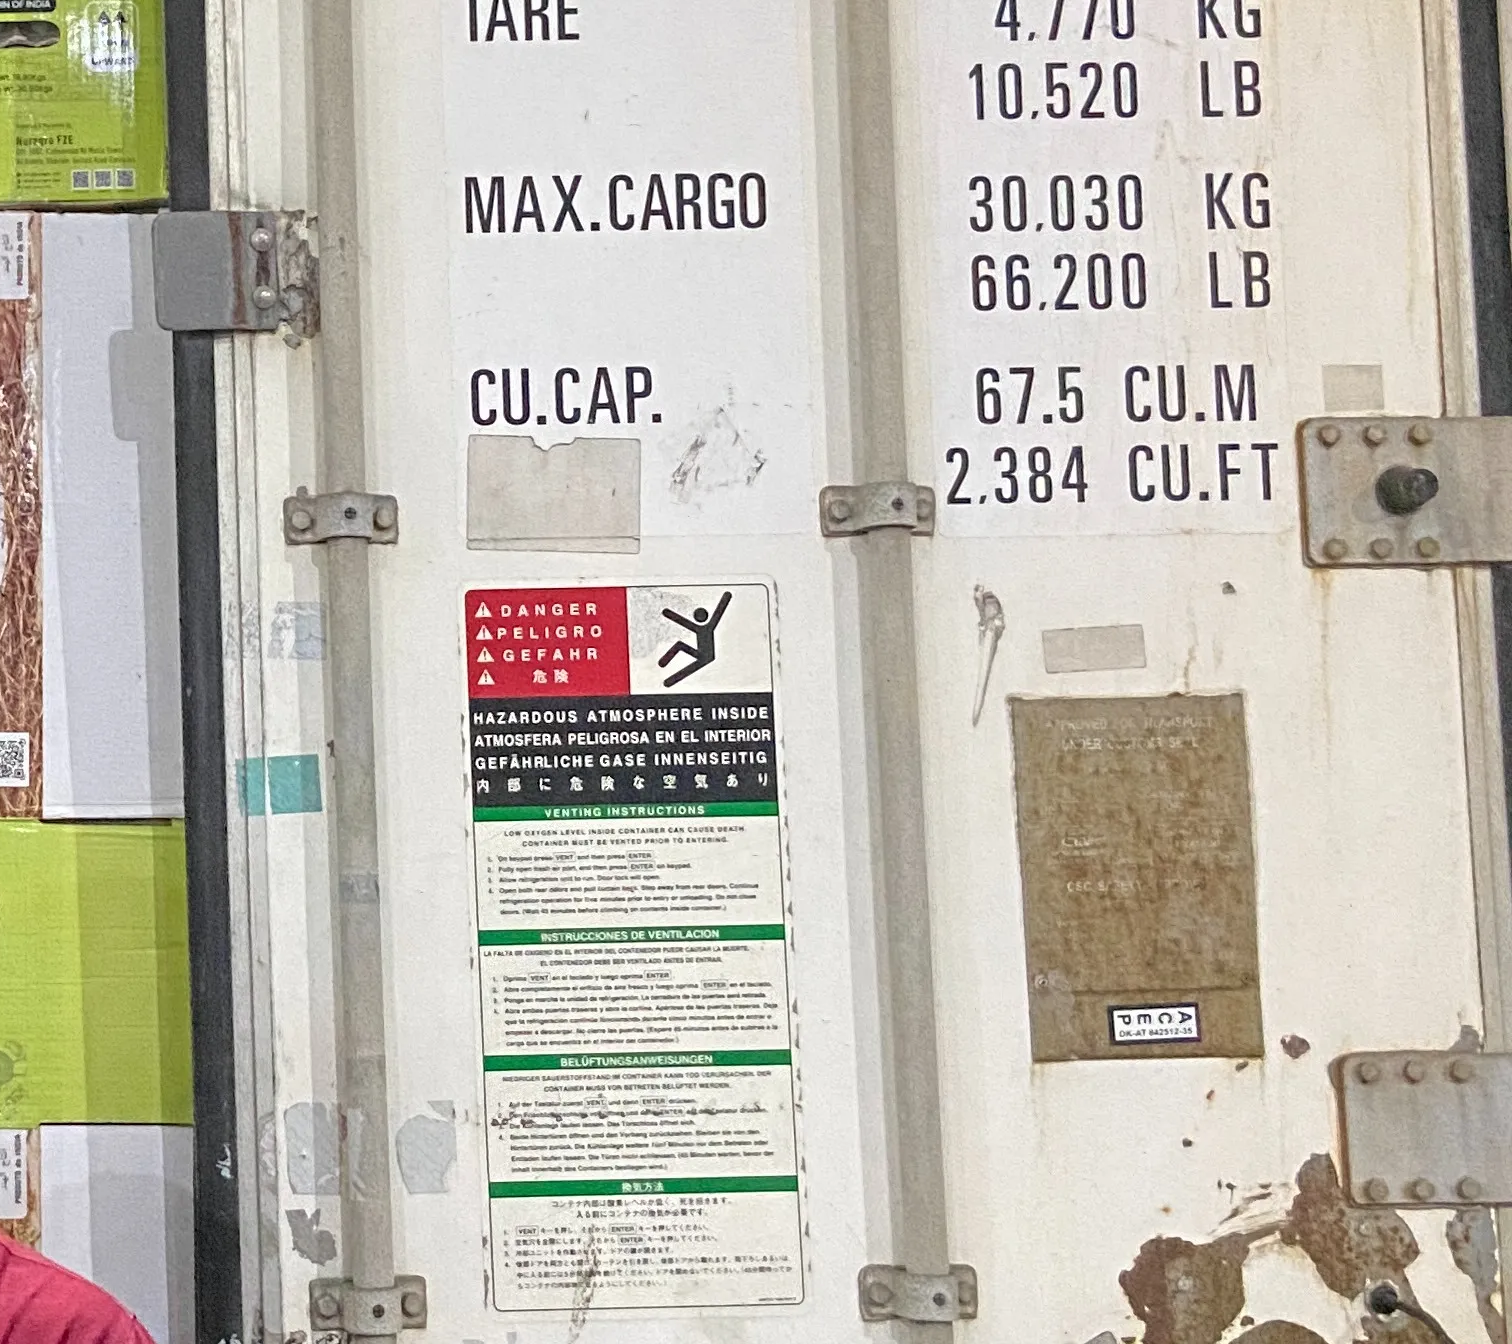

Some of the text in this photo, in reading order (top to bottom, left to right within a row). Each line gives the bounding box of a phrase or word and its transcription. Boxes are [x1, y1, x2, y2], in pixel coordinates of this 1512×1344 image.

[1202, 63, 1262, 118] LB
[464, 174, 767, 233] MAX.CARGO
[1205, 174, 1271, 230] KG
[1209, 253, 1271, 309] LB
[470, 367, 663, 426] CU.CAP.
[976, 366, 1258, 424] 67.5 CU.M
[1129, 444, 1279, 503] CU.FT
[501, 603, 597, 618] DANGER
[497, 625, 602, 639] PELIGRO
[504, 648, 598, 662] GEFAHR
[533, 669, 569, 684] 危険
[474, 707, 768, 725] HAZARDOUS ATMOSPHERE INSIDE
[475, 729, 771, 747] ATMOSFERA PELIGROSA EN EL INTERIOR
[476, 751, 767, 770] GEFÄHRLICHE GASE INNENSEITIG
[544, 805, 705, 818] VENTING INSTRUCTIONS
[541, 929, 719, 942] INSTRUCCIONES DE VENTILACION
[560, 1055, 713, 1067] BELÜFTUNGSANWEISUNGEN
